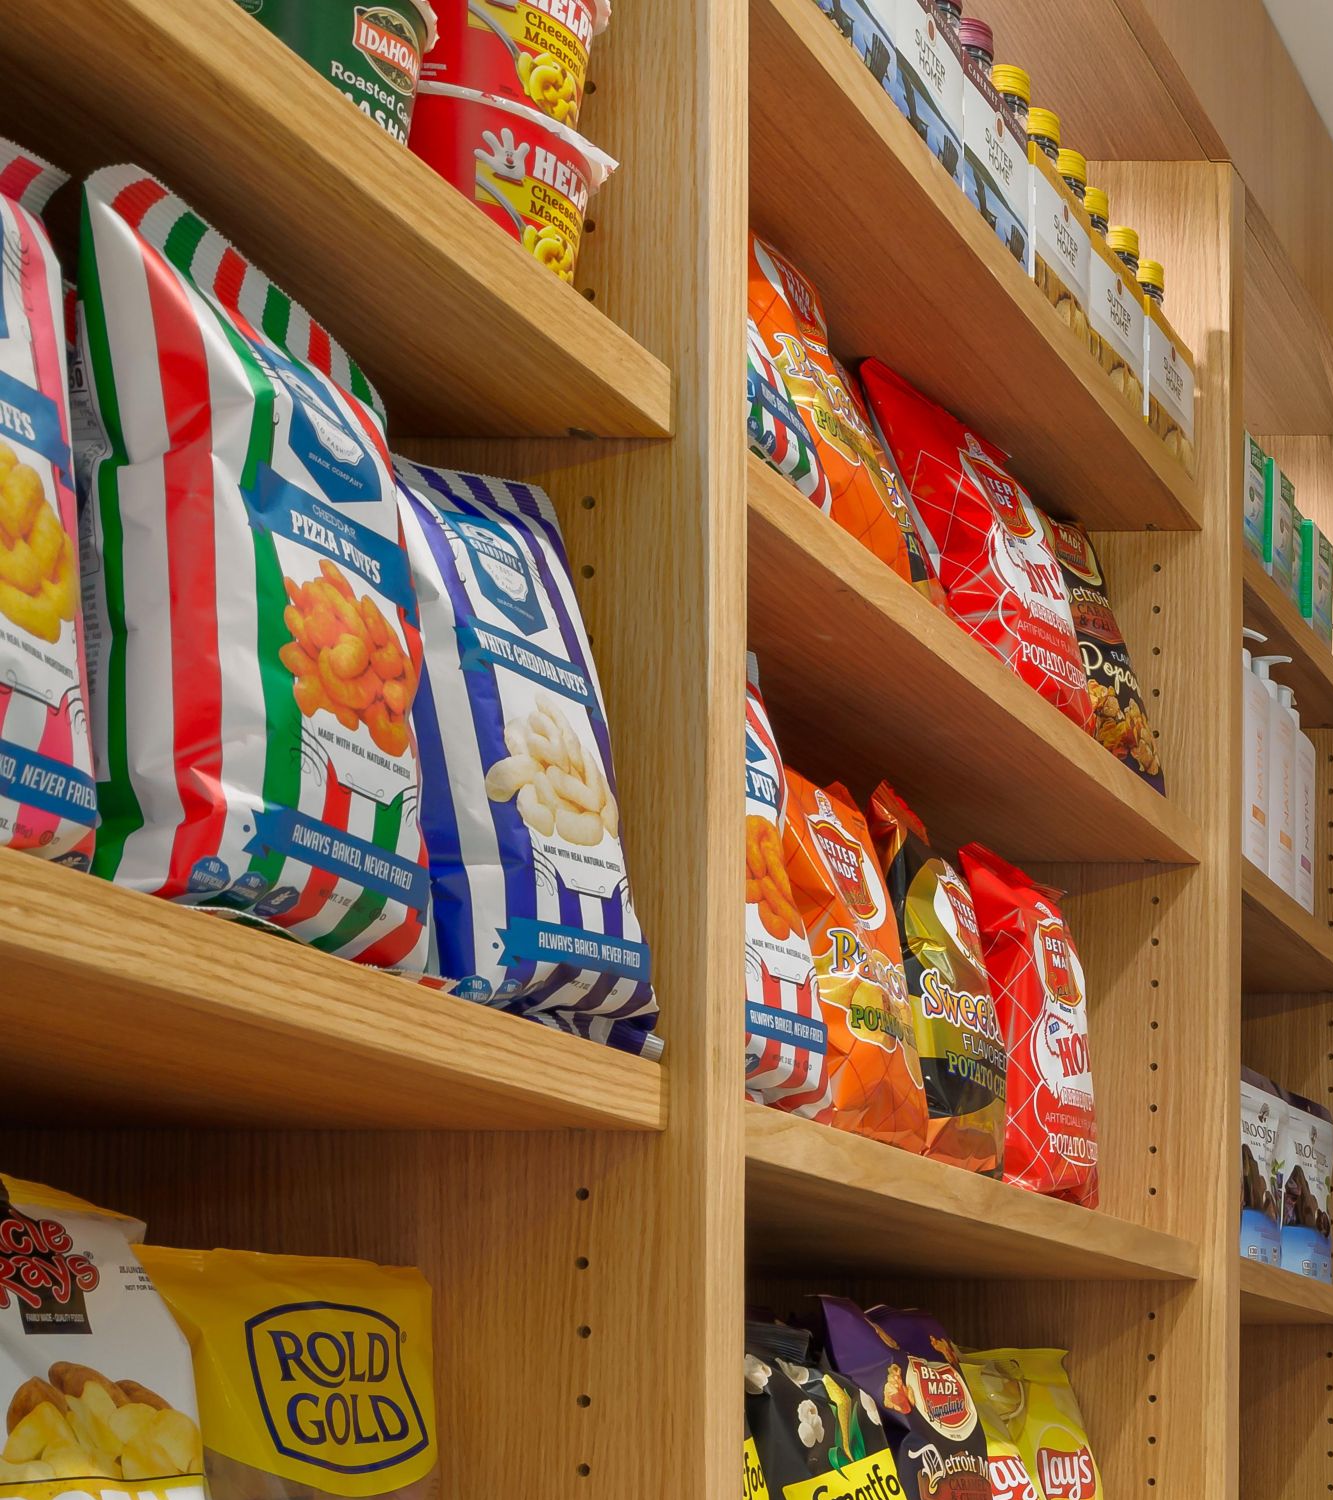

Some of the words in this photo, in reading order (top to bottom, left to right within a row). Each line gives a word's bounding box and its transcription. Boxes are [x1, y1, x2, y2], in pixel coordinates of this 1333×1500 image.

[915, 28, 946, 78] SUTTER
[919, 54, 944, 95] HOME
[330, 60, 395, 111] Roasted
[985, 127, 1013, 173] SUTTER
[988, 147, 1010, 186] HOME
[1054, 214, 1078, 255] SUTTER
[1056, 232, 1076, 268] HOME
[312, 503, 357, 539] CHEDDAR
[290, 510, 341, 557] PIZZA
[341, 535, 382, 585] PUFFS
[477, 628, 514, 661] WHITE
[513, 642, 560, 681] CHEDDAR
[557, 668, 589, 698] PUFFS
[317, 727, 335, 743] MADE
[335, 733, 351, 749] WITH
[351, 740, 366, 759] REAL
[367, 746, 392, 771] NATURAL
[1256, 729, 1265, 801] NATIVE
[20, 764, 63, 803] NEVER
[66, 780, 97, 812] FRIED
[1303, 781, 1311, 850] NATIVE
[209, 860, 220, 874] NO
[292, 824, 331, 856] ALWAYS
[331, 841, 363, 873] BAKED,
[363, 854, 389, 884] NEVER
[390, 866, 413, 891] FRIED
[818, 833, 858, 868] BETTER
[538, 931, 574, 953] ALWAYS
[574, 938, 601, 961] BAKED,
[601, 943, 622, 965] NEVER
[622, 946, 641, 969] FRIED
[947, 1051, 993, 1093] POTATO
[1049, 1131, 1086, 1162] POTATO
[266, 1329, 391, 1388] ROLD
[927, 1381, 960, 1396] MADE
[285, 1391, 411, 1447] GOLD
